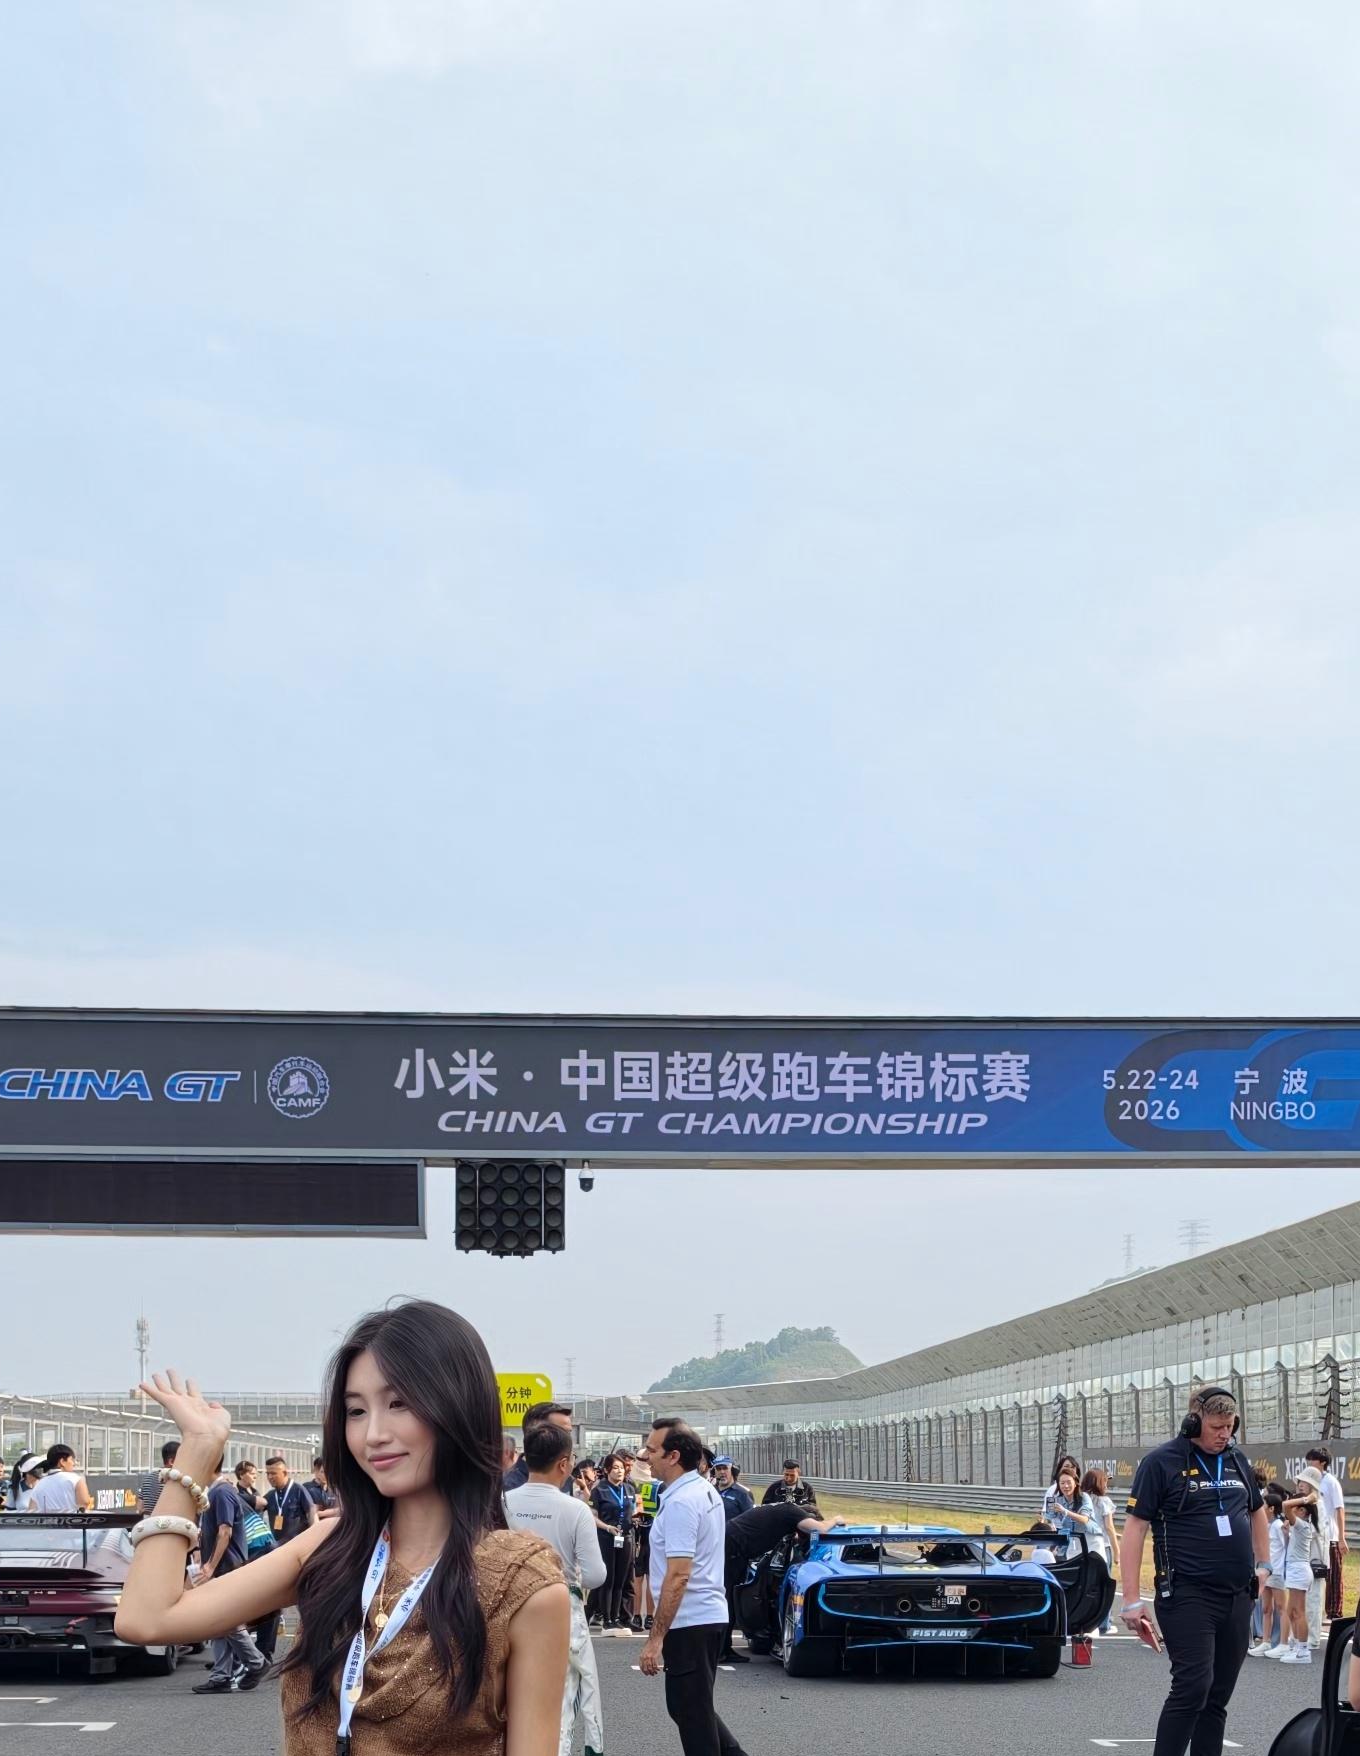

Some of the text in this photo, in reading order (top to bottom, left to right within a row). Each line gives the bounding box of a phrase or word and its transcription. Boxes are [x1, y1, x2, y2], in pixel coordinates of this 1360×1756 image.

[164, 1069, 242, 1101] GT
[1103, 1070, 1199, 1090] 5.22-24
[276, 1098, 321, 1108] CAMF
[1119, 1100, 1180, 1120] 2026
[1230, 1101, 1316, 1120] NINGBO
[438, 1111, 988, 1135] CHINA GT CHAMPIONSHIP
[506, 1387, 532, 1399] 分钟
[948, 1597, 960, 1605] PA
[912, 1629, 968, 1637] FIST AUTO
